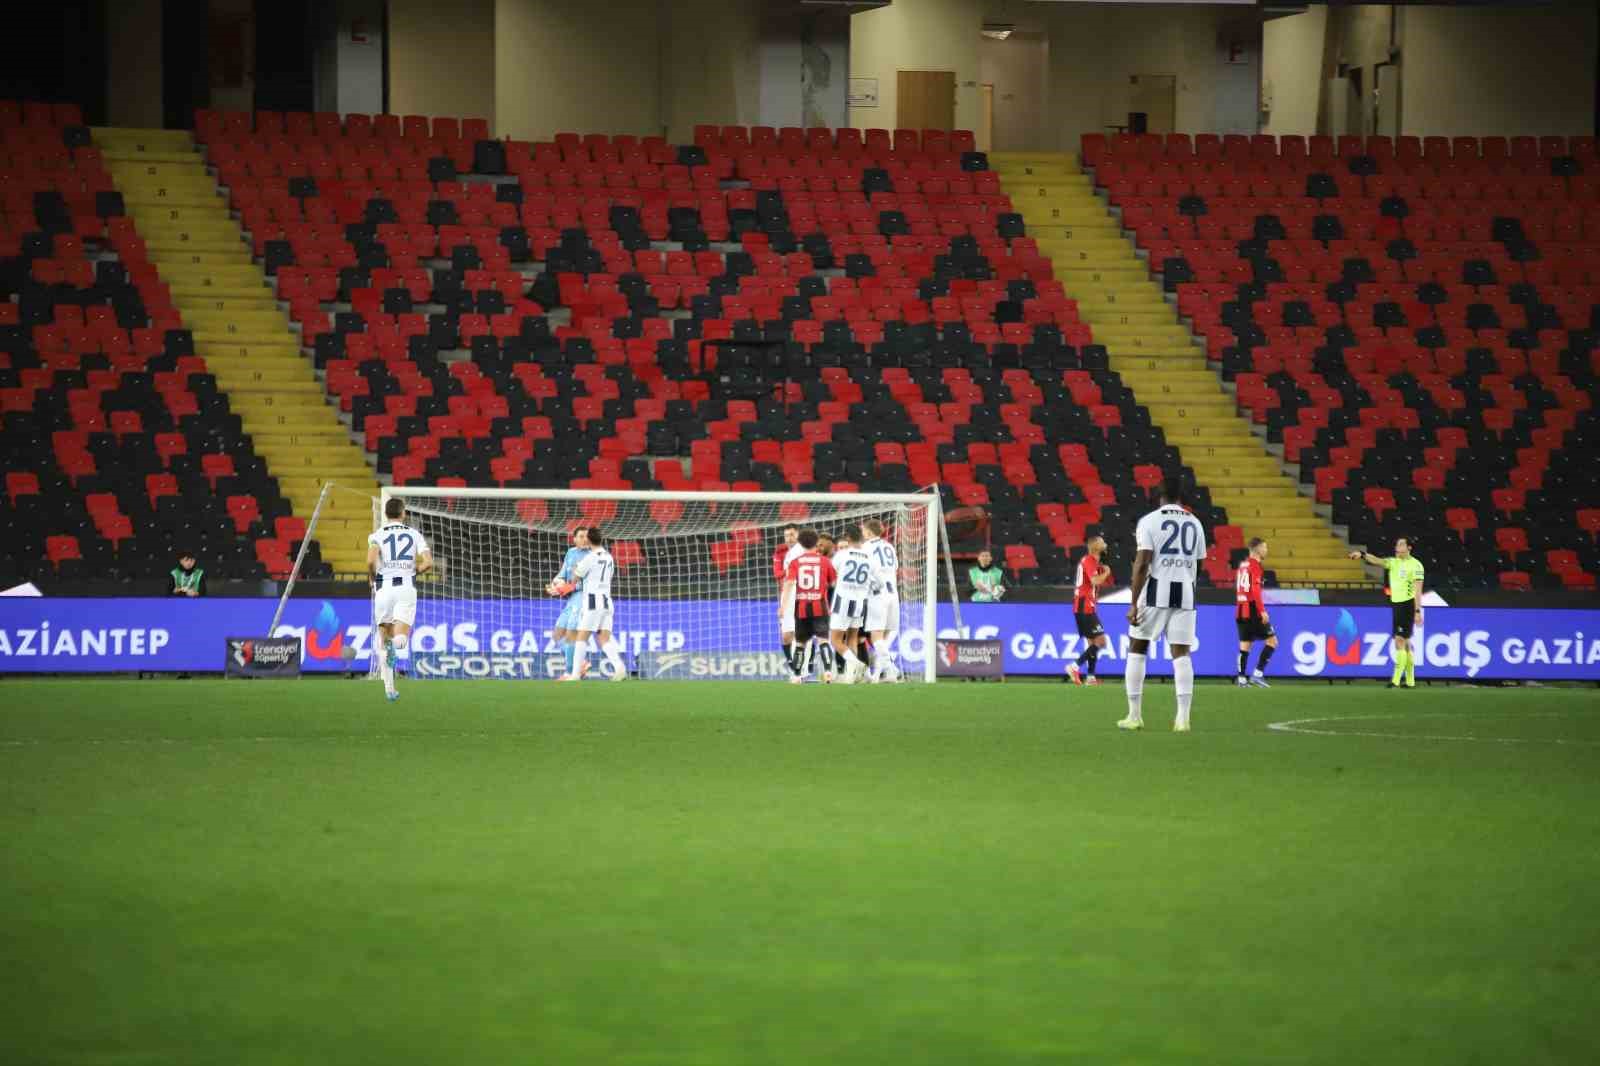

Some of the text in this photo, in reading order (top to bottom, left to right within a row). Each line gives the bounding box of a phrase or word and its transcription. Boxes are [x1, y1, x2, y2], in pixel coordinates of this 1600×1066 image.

[383, 533, 413, 561] 12
[1160, 520, 1197, 556] 20
[873, 546, 895, 567] 19
[798, 565, 821, 590] 61
[843, 560, 870, 585] 26
[1236, 569, 1250, 593] 14
